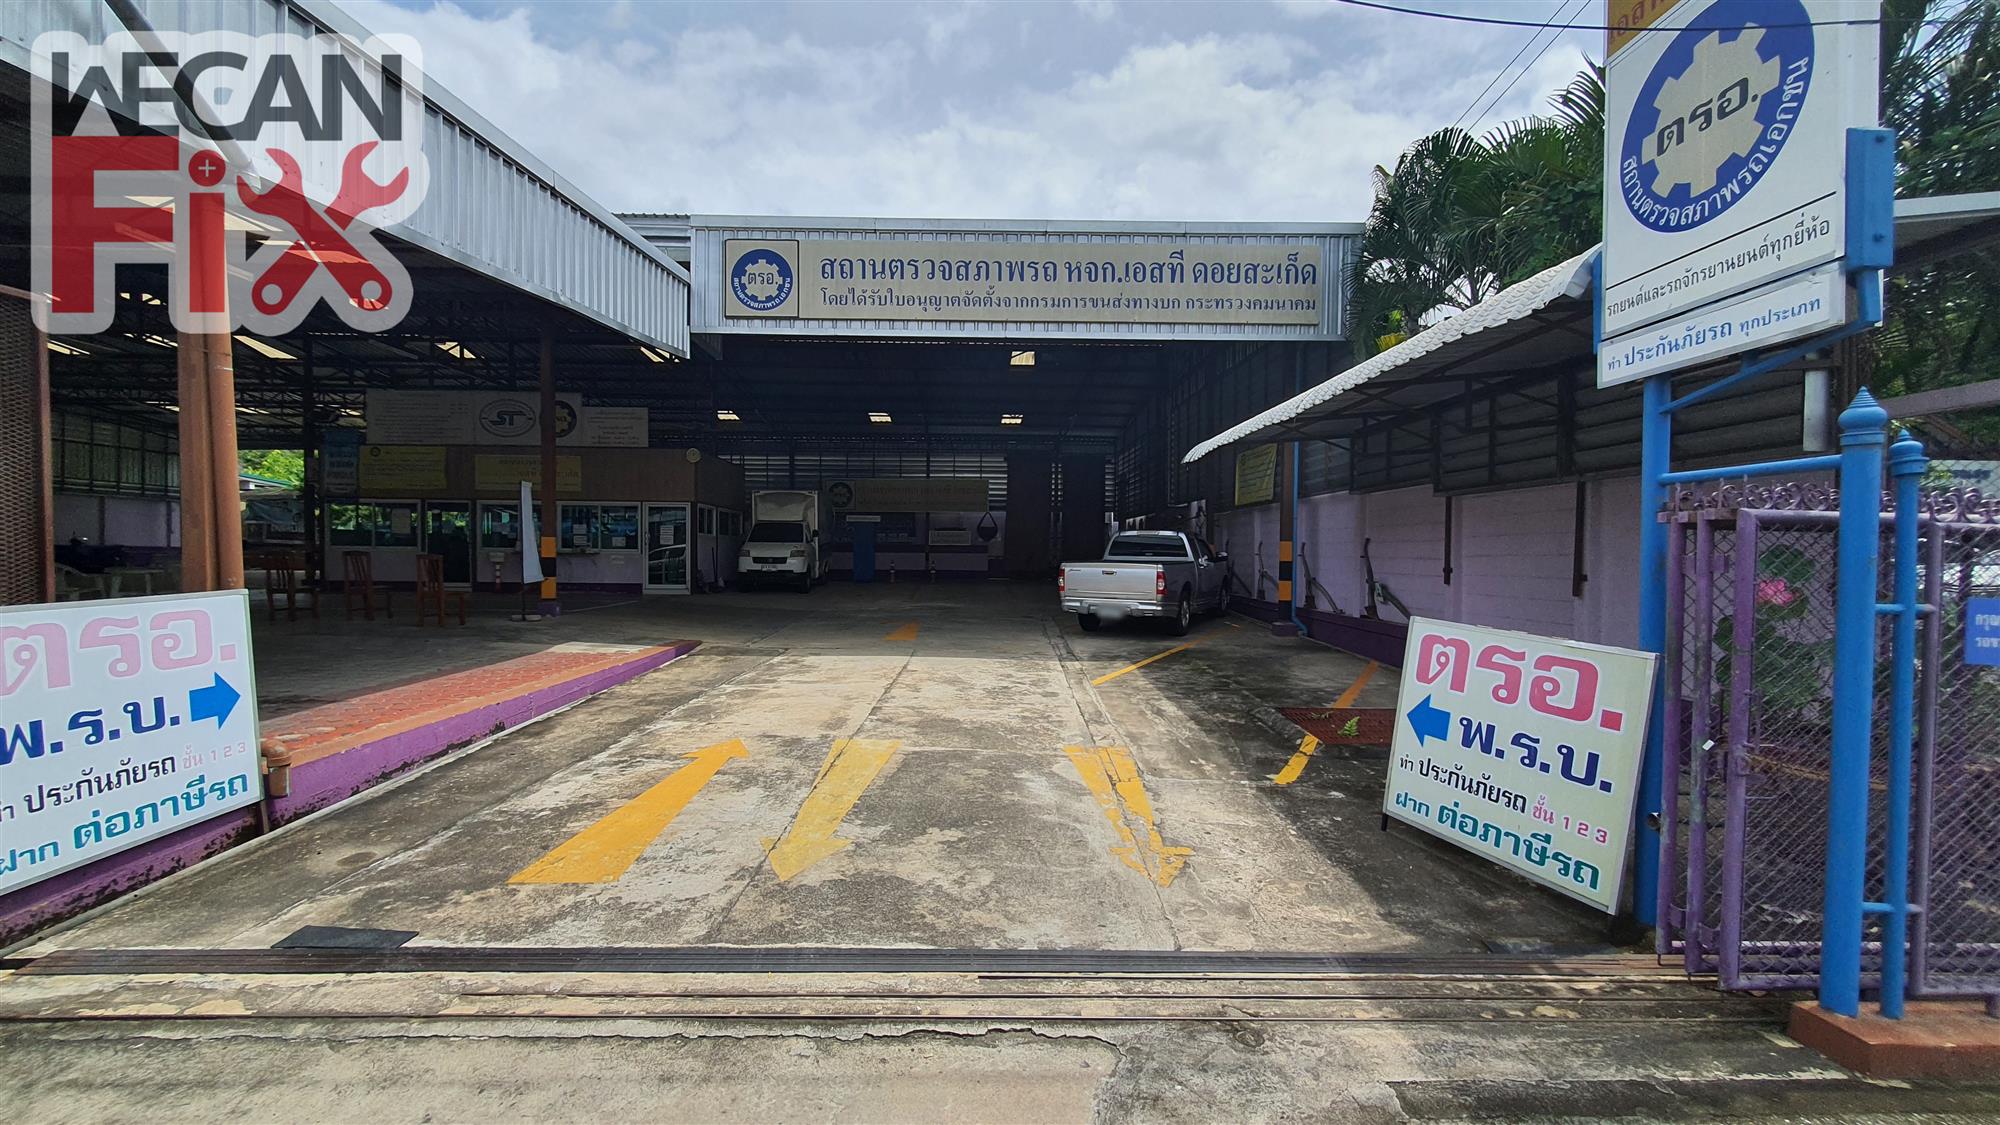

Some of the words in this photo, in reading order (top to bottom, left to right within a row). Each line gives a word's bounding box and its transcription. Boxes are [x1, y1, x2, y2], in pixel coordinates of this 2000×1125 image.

[1623, 57, 1809, 226] สถานตรวจสภาพรถเอกชน
[1656, 77, 1759, 156] ตรอ.
[747, 272, 778, 285] ตรอ.
[820, 257, 1057, 283] สถานตรวจสภาพรถ
[1064, 250, 1184, 284] หจก.เอสที
[1192, 252, 1317, 285] ดอยสะเก็ด
[821, 285, 1180, 312] โดยได้รับใบอนุญาตจัดตั้งจากกรมการขนส่งทางบก
[1186, 294, 1316, 311] กระทรวงคมนาคม
[1607, 213, 1830, 317] รถยนต์และรถจักรยานยนต์ทุกยี่ห้อ
[1607, 356, 1621, 371] ทำ
[1624, 319, 1732, 366] ประกันภัยรถ
[1739, 297, 1821, 334] ทุกประเภท
[0, 609, 237, 697] ตรอ.
[1415, 634, 1623, 731] ตรอ.
[23, 757, 176, 814] ประกันภัยรถ
[210, 750, 217, 760] 1
[223, 745, 233, 757] 2
[237, 741, 247, 754] 3
[1459, 716, 1613, 793] พ.ร.บ.
[73, 773, 249, 850] ต่อภาษีรถ
[1400, 754, 1414, 772] ทำ
[1418, 757, 1527, 813] ประกันภัยรถ
[1532, 795, 1555, 824] ชั้น
[1563, 815, 1570, 830] 1
[1577, 824, 1589, 838] 2
[1595, 828, 1608, 844] 3
[1396, 790, 1430, 818] ฝาก
[1438, 800, 1601, 891] ต่อภาษีรถ
